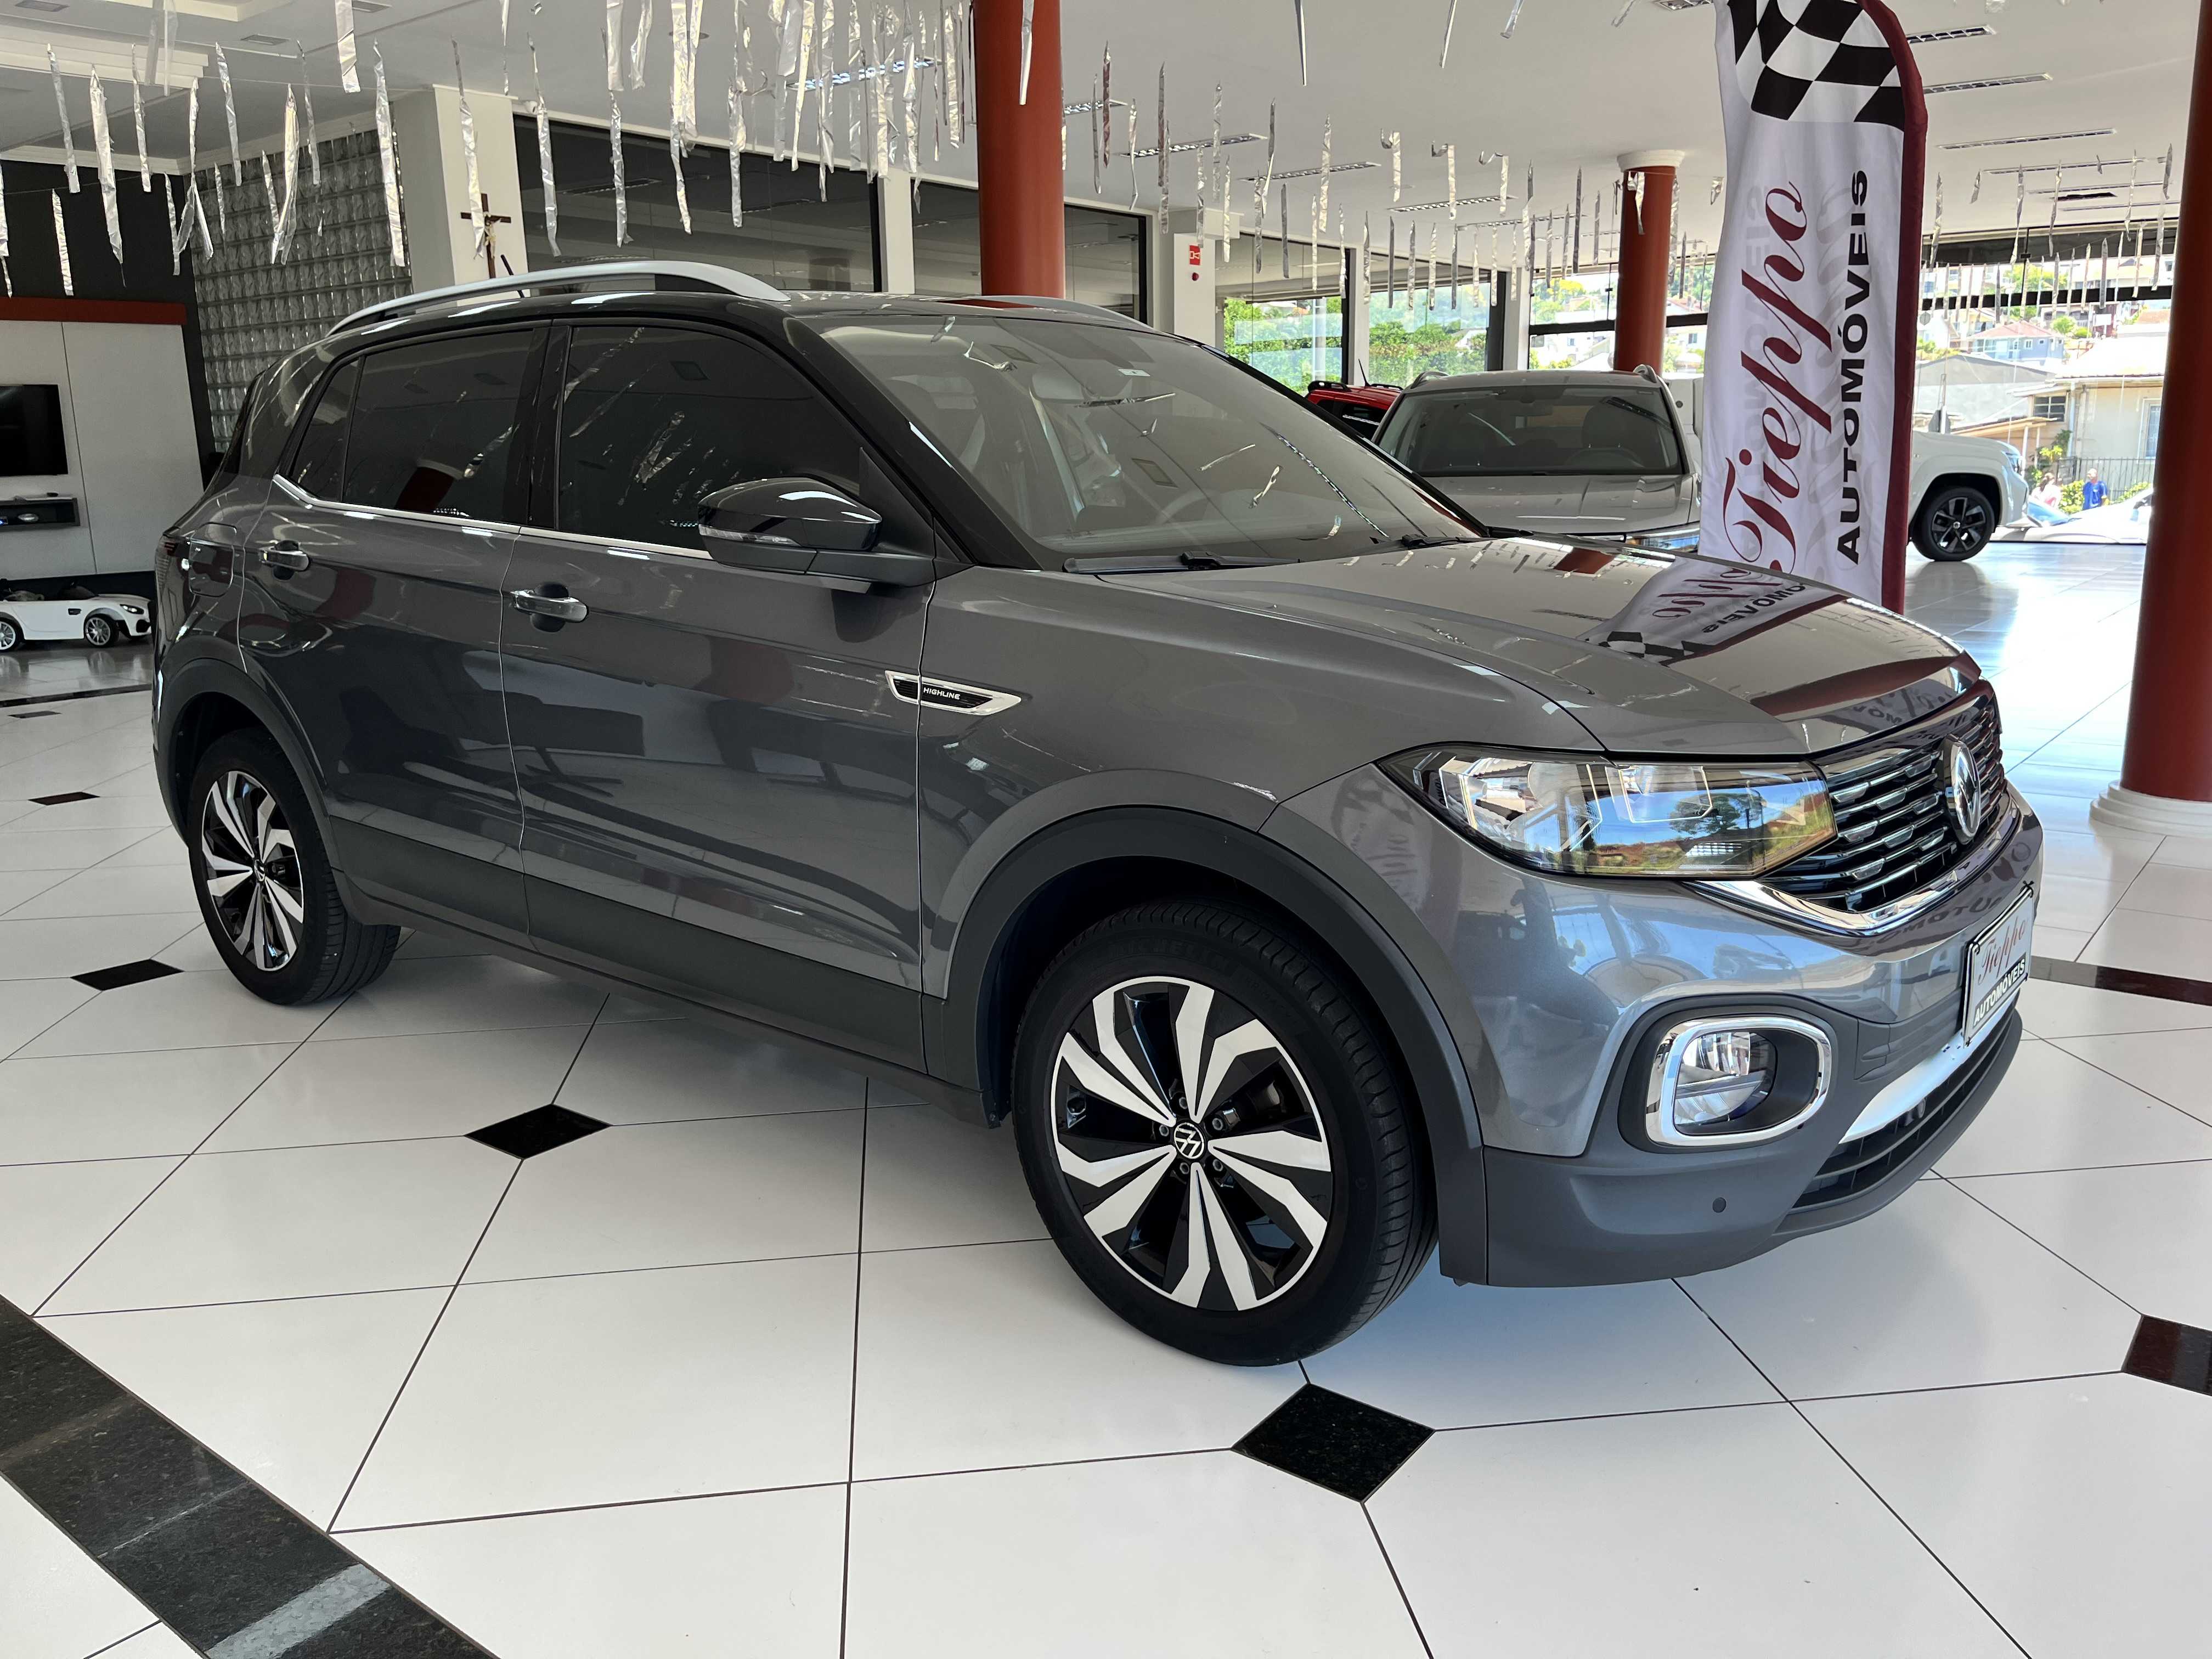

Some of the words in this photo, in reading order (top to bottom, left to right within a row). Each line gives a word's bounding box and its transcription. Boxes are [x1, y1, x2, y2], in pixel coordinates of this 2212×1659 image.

[1723, 181, 1832, 574] Tieppo
[1837, 170, 1870, 565] AUTOMÓVEIS
[923, 687, 961, 700] HIGHLINE
[1978, 915, 2029, 985] Tieppo
[1973, 958, 2025, 1026] AUTOMÓVEIS
